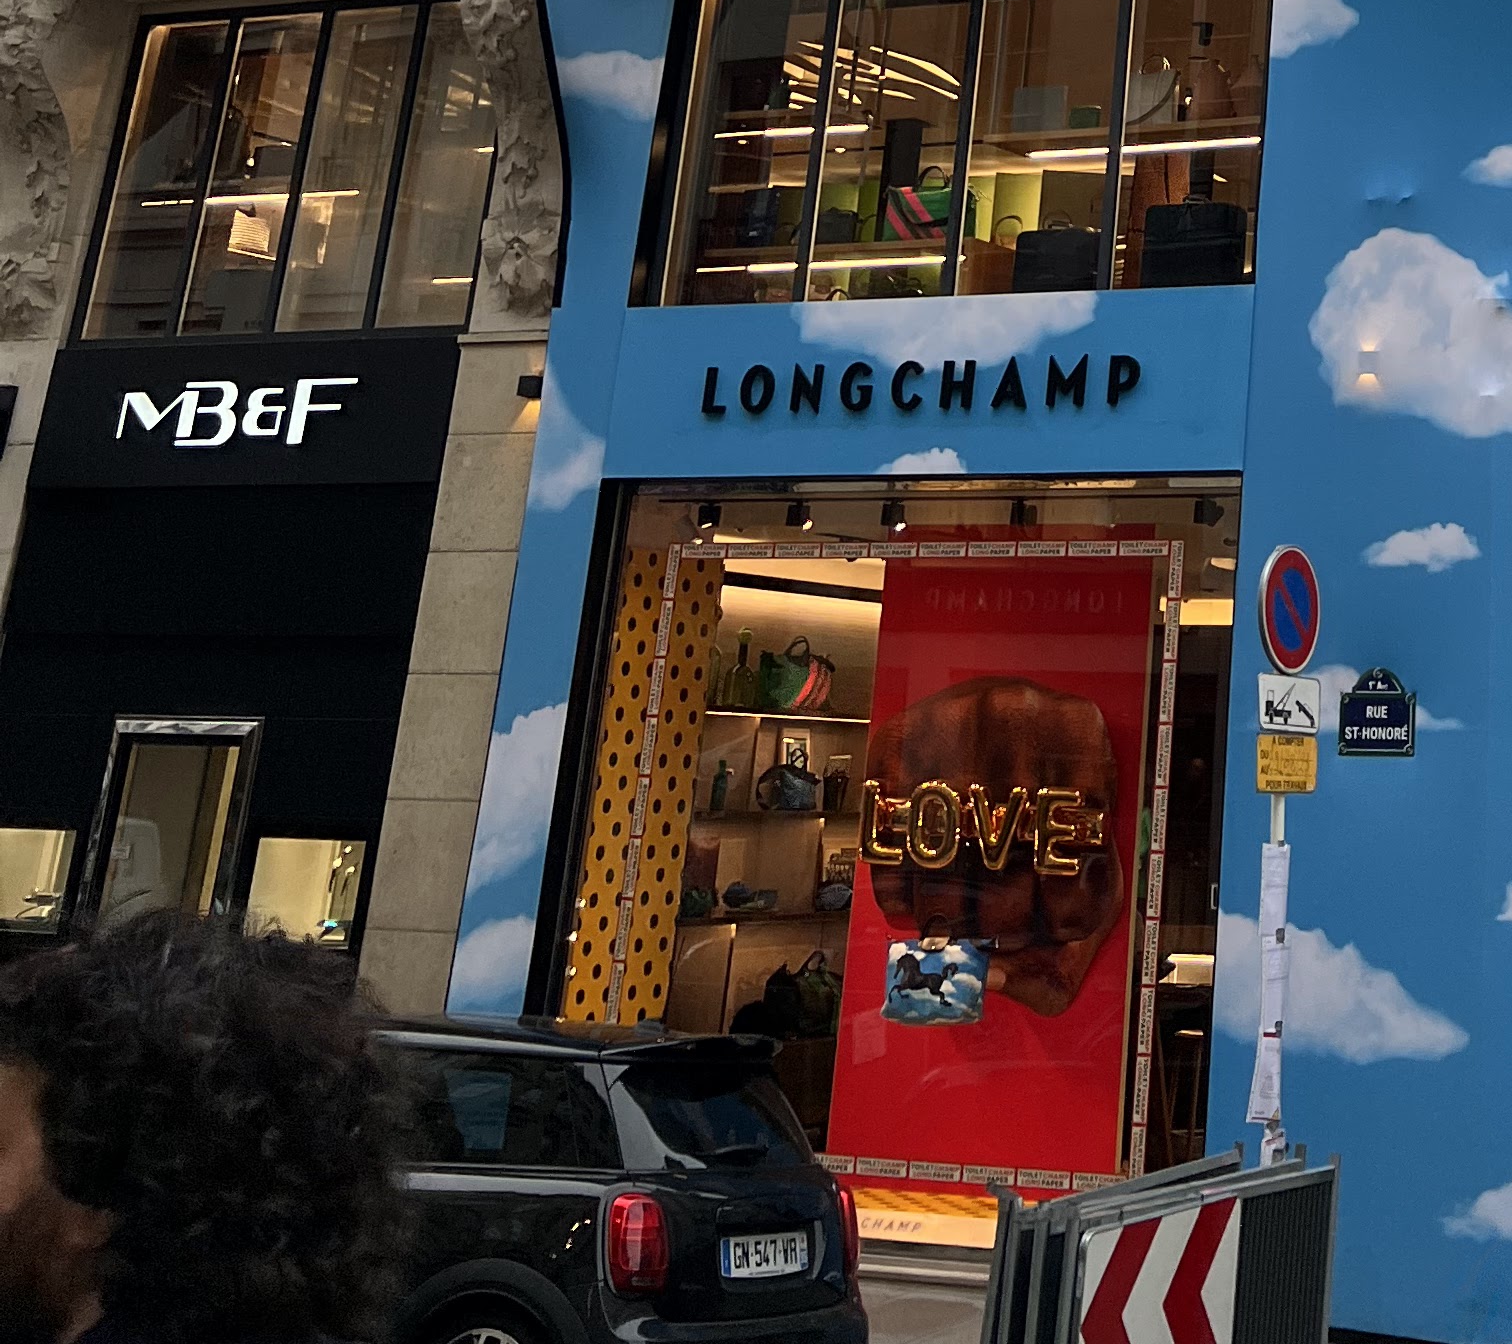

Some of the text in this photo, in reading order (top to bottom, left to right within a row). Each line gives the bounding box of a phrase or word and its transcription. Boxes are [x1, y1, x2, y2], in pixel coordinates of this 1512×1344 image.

[116, 377, 359, 447] MB&F
[700, 353, 1142, 415] LONGCHAMP
[1366, 705, 1388, 719] RUE
[859, 779, 1080, 877] LOVE
